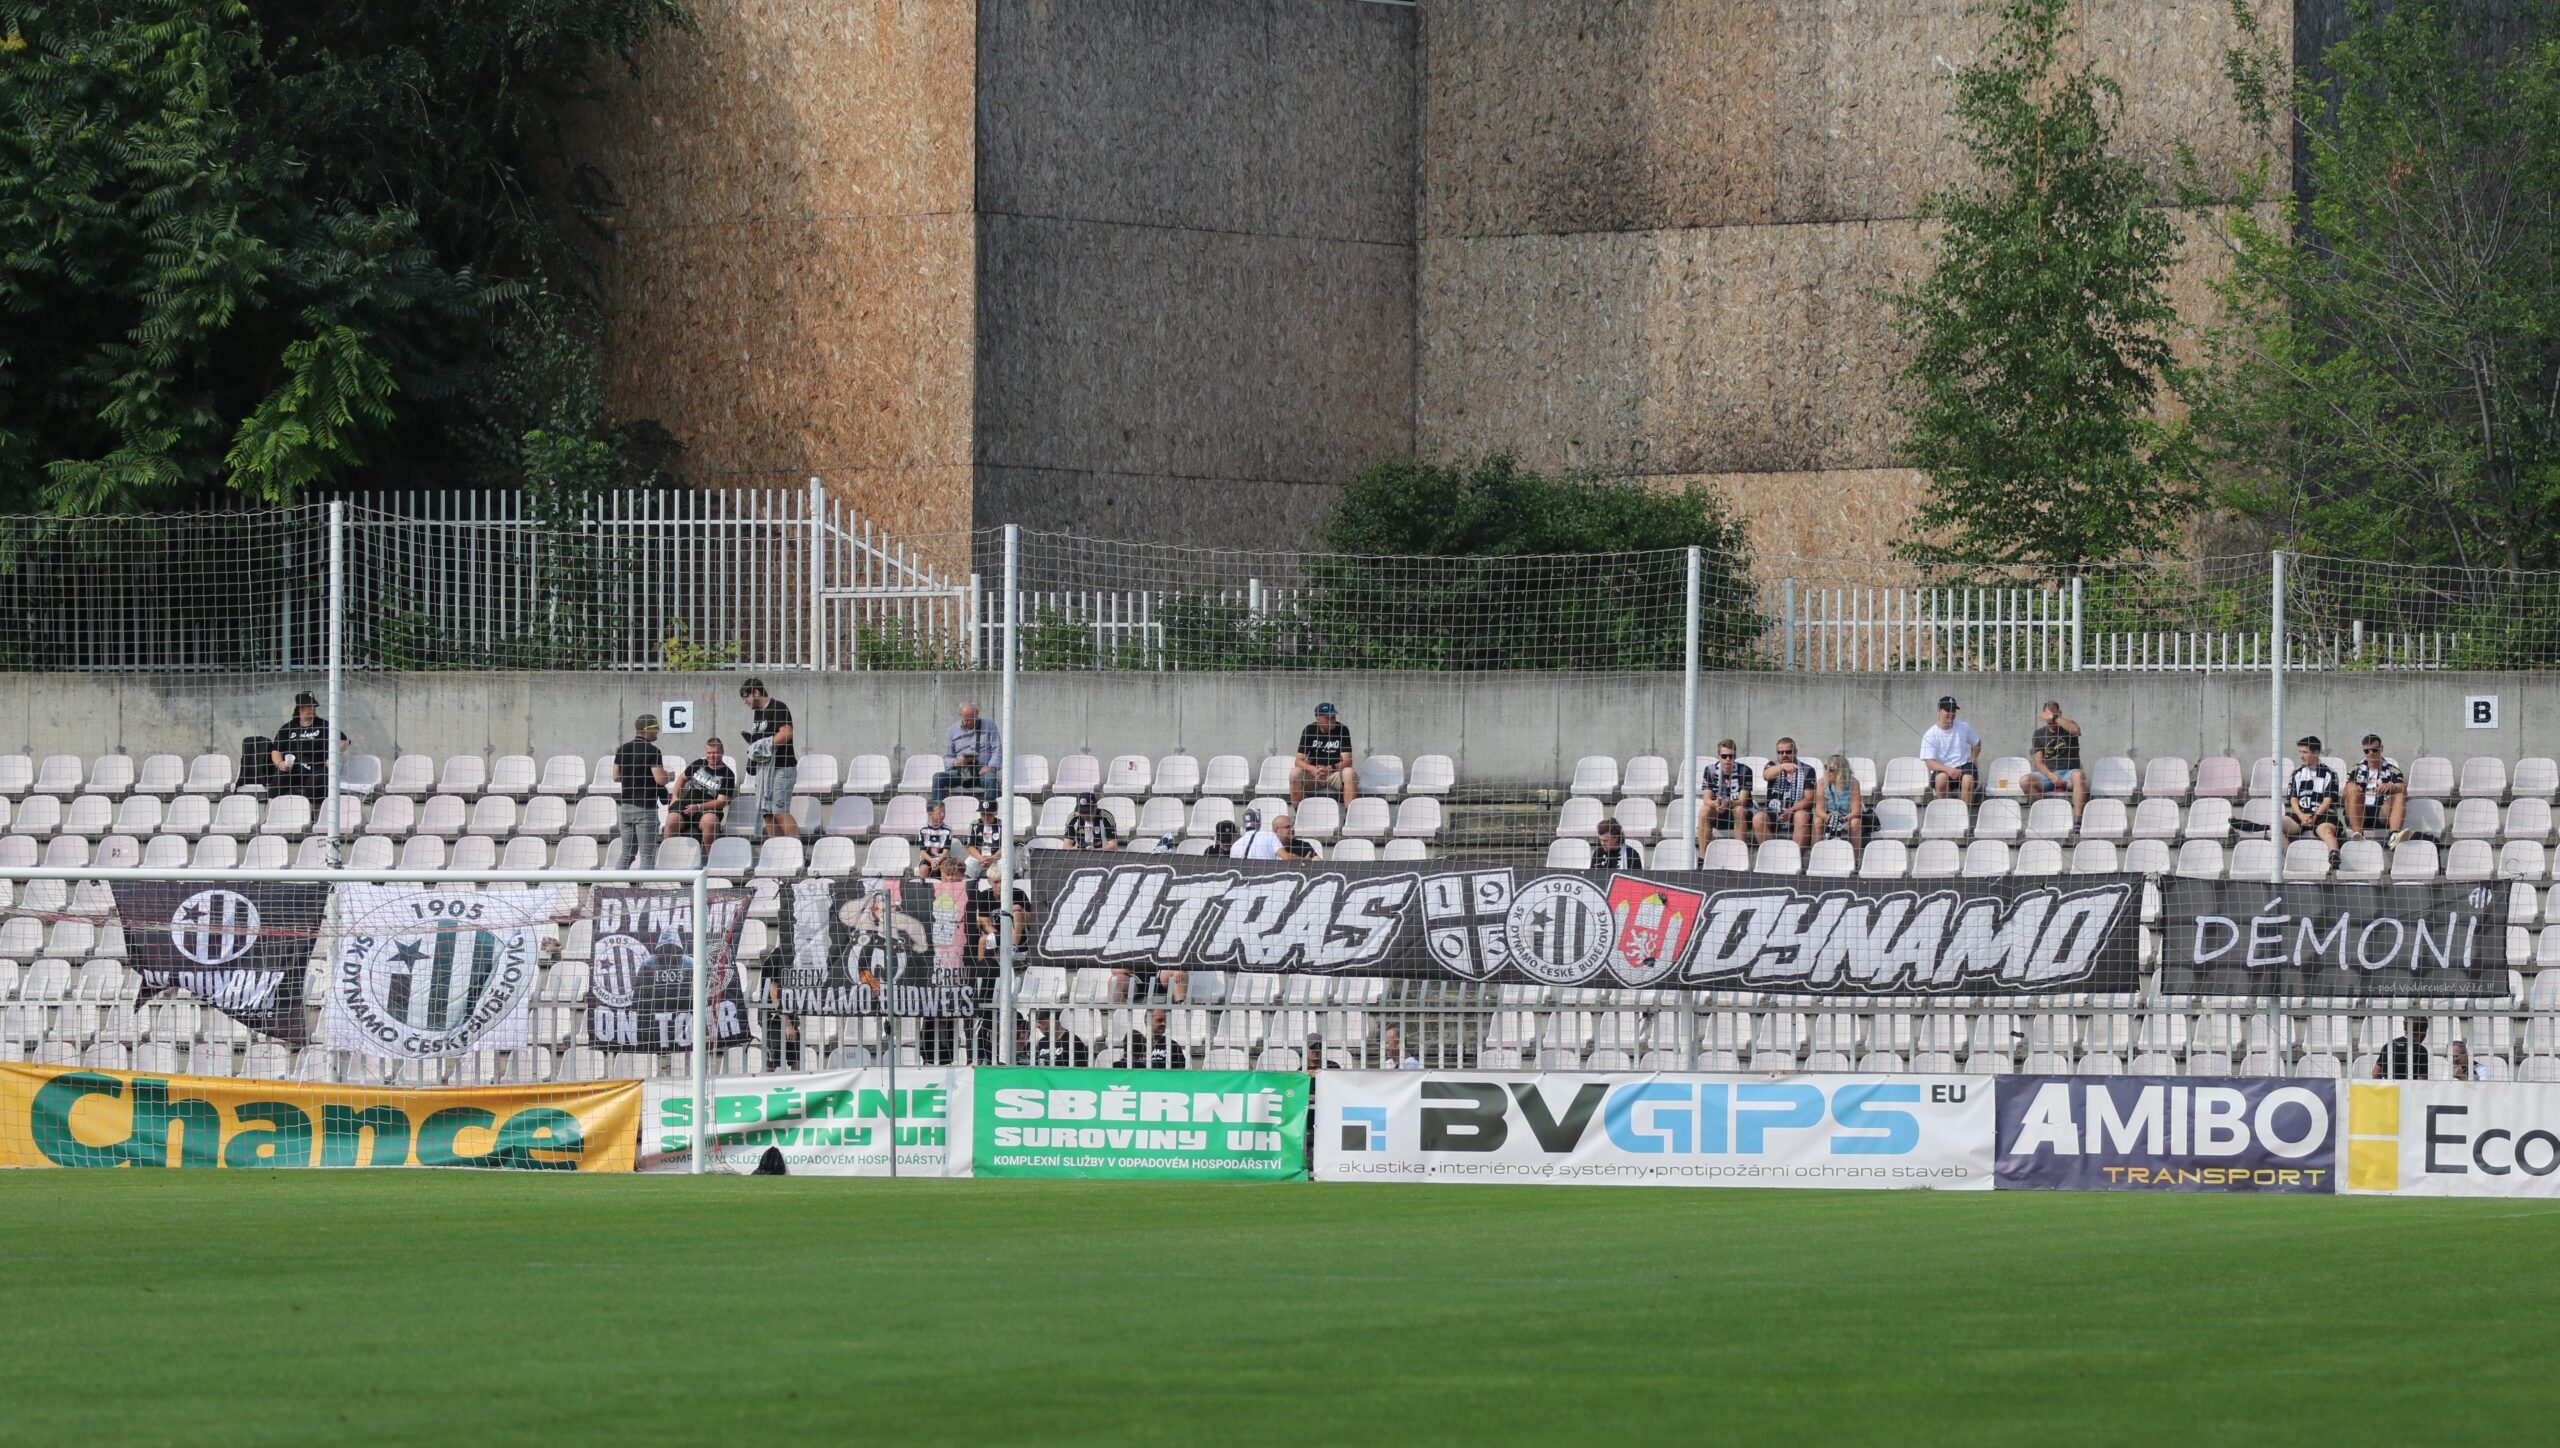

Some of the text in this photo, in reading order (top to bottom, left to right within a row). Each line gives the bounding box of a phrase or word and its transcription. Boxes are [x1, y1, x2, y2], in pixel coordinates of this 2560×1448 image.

[668, 706, 687, 729] C
[2472, 700, 2492, 724] B
[1542, 882, 1584, 896] 1905
[410, 899, 485, 920] 1905
[1043, 870, 1417, 968] ULTRAS
[1511, 905, 1525, 921] SK
[346, 935, 375, 961] SK
[1509, 925, 1539, 968] DYNAMO
[1686, 889, 2124, 986] DYNAMO
[469, 928, 525, 1034] BUDĚJOVIC
[780, 968, 825, 987] OBELIX
[935, 967, 971, 987] CREW
[1539, 964, 1576, 978] ČESKÉ
[781, 984, 872, 1015] DYNAMO
[2378, 981, 2396, 994] pod
[342, 961, 399, 1043] DYNAMO
[594, 1000, 741, 1048] ON TOR
[660, 1082, 948, 1128] SBĚRNÉ
[994, 1084, 1283, 1124] SBĚRNÉ
[31, 1071, 585, 1170] Chance
[1420, 1081, 1967, 1155] BVGIPS EU
[2010, 1082, 2329, 1158] AMIBO
[660, 1126, 946, 1152] SROVINY UH
[994, 1126, 1282, 1151] SUROVINY UH
[2425, 1104, 2560, 1177] Eco
[729, 1151, 763, 1165] SLUŽ
[784, 1151, 855, 1165] ODPADOVÉM
[857, 1152, 947, 1166] HOSPDÁŘSTVÍ
[993, 1154, 1282, 1170] KOMPLEXNÍ SLUŽBY V ODPADOVÉM HOSPODÁŘSTVÍ
[1338, 1160, 1968, 1180] akustika interiérové systémy protipožární ochrana staveb
[2102, 1166, 2326, 1186] TRANSPORT
